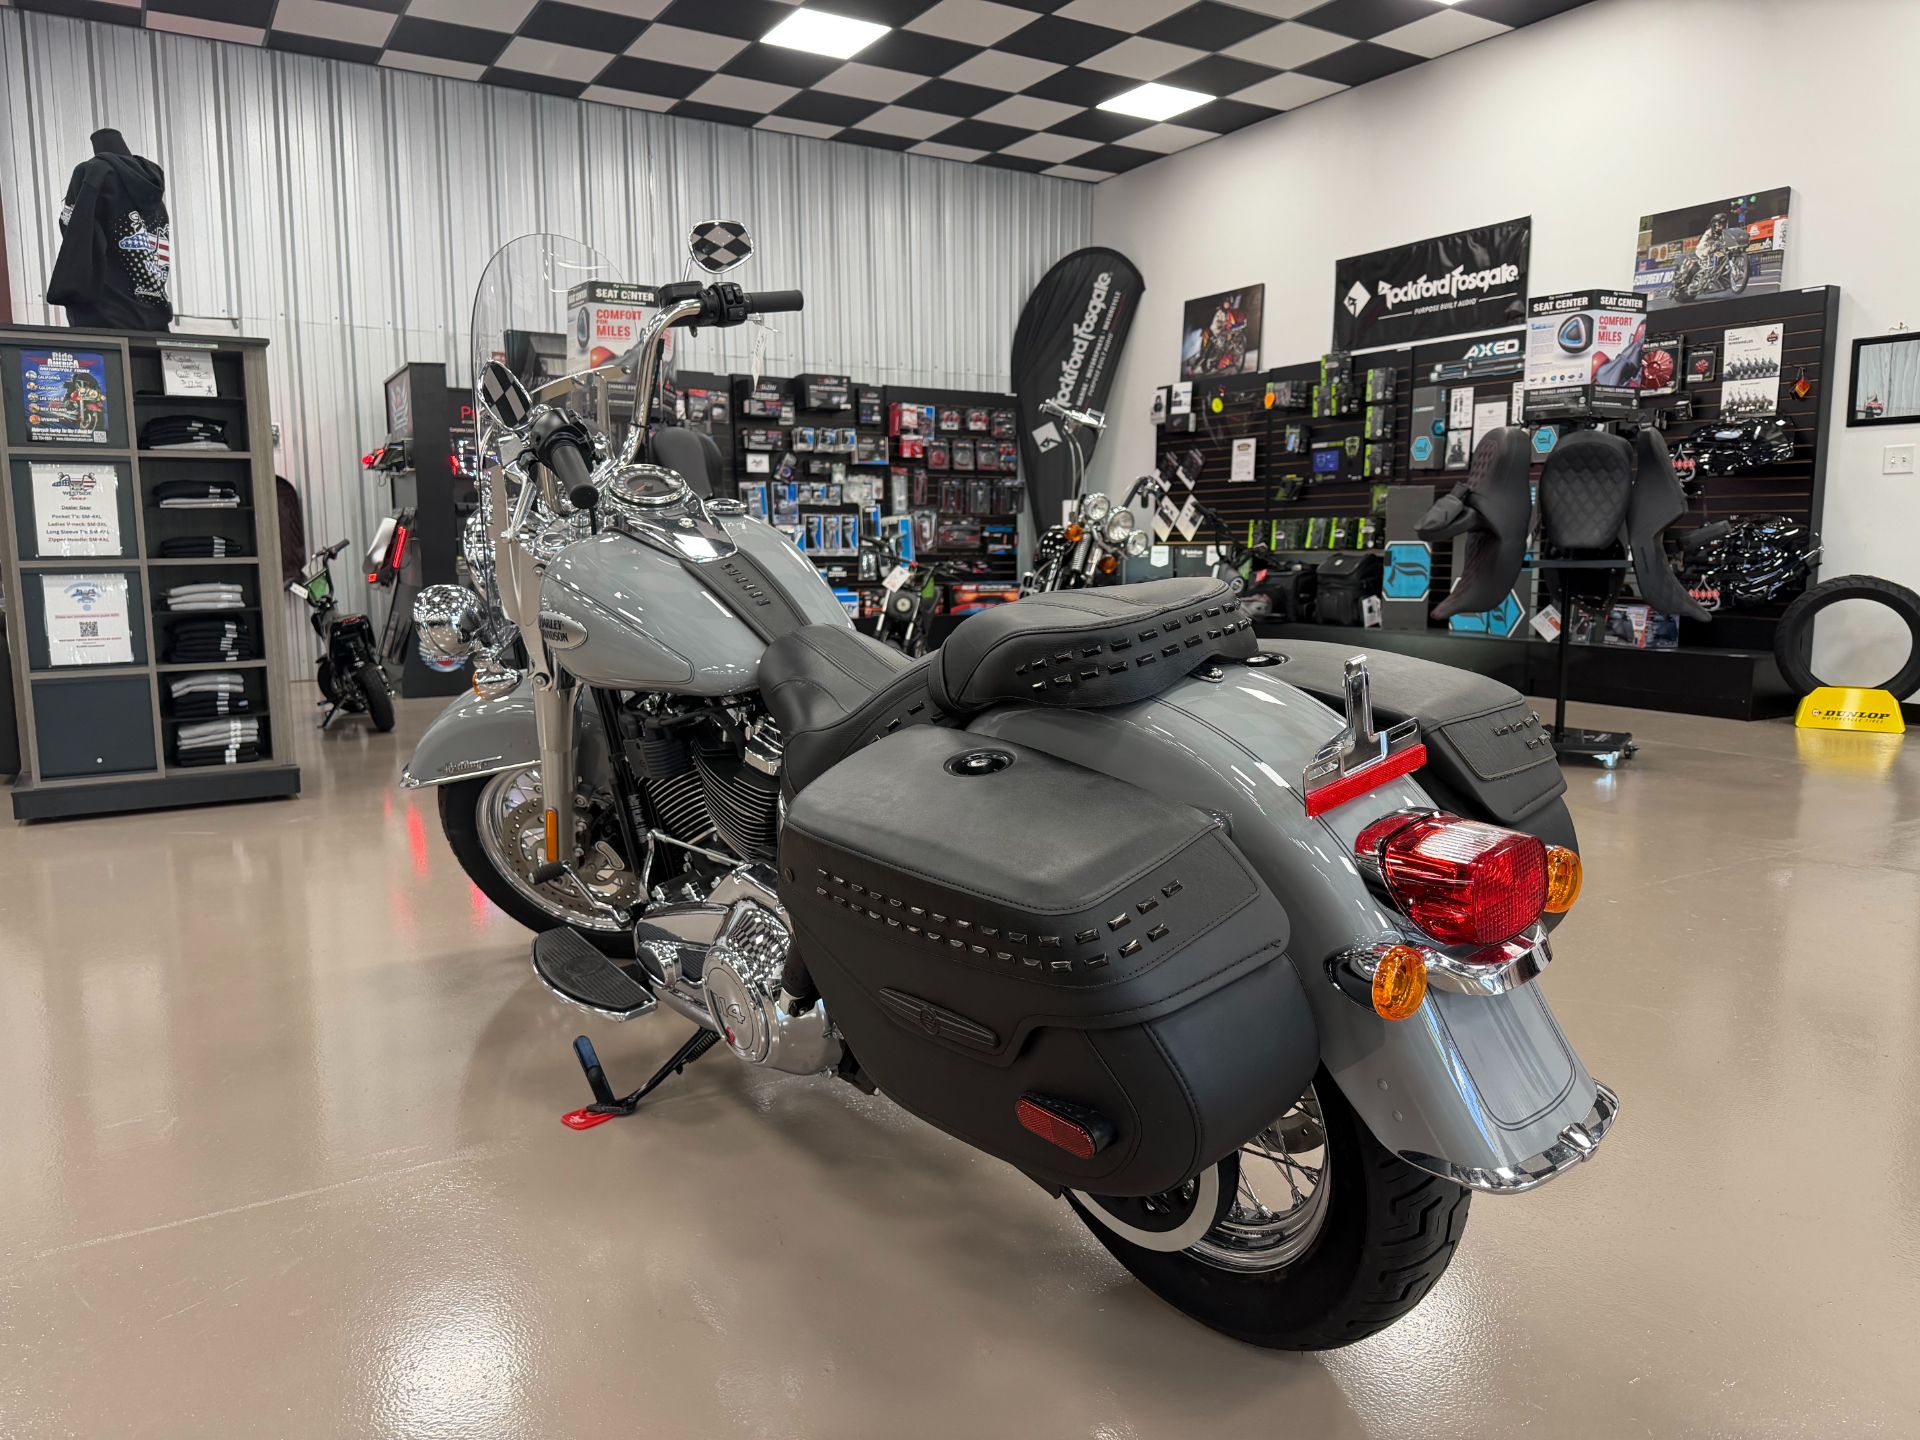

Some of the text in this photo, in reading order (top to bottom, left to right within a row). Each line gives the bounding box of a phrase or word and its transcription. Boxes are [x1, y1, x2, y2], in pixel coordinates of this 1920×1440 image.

[1378, 264, 1518, 310] Rockford Fosgate
[595, 288, 655, 302] SEAT CENTER
[1413, 304, 1440, 315] PURPOSE
[1440, 300, 1458, 310] BUILT
[1533, 301, 1554, 313] SEAT
[1555, 296, 1589, 310] CENTER
[1600, 296, 1618, 306] SEAT
[1617, 298, 1643, 309] CENTER
[596, 309, 642, 320] COMFORT
[1599, 315, 1633, 327] COMFORT
[596, 325, 631, 337] MILES
[1597, 331, 1622, 342] MILES
[52, 352, 74, 362] Ride
[47, 358, 80, 369] AMERICA
[1823, 710, 1891, 719] DUNLOP
